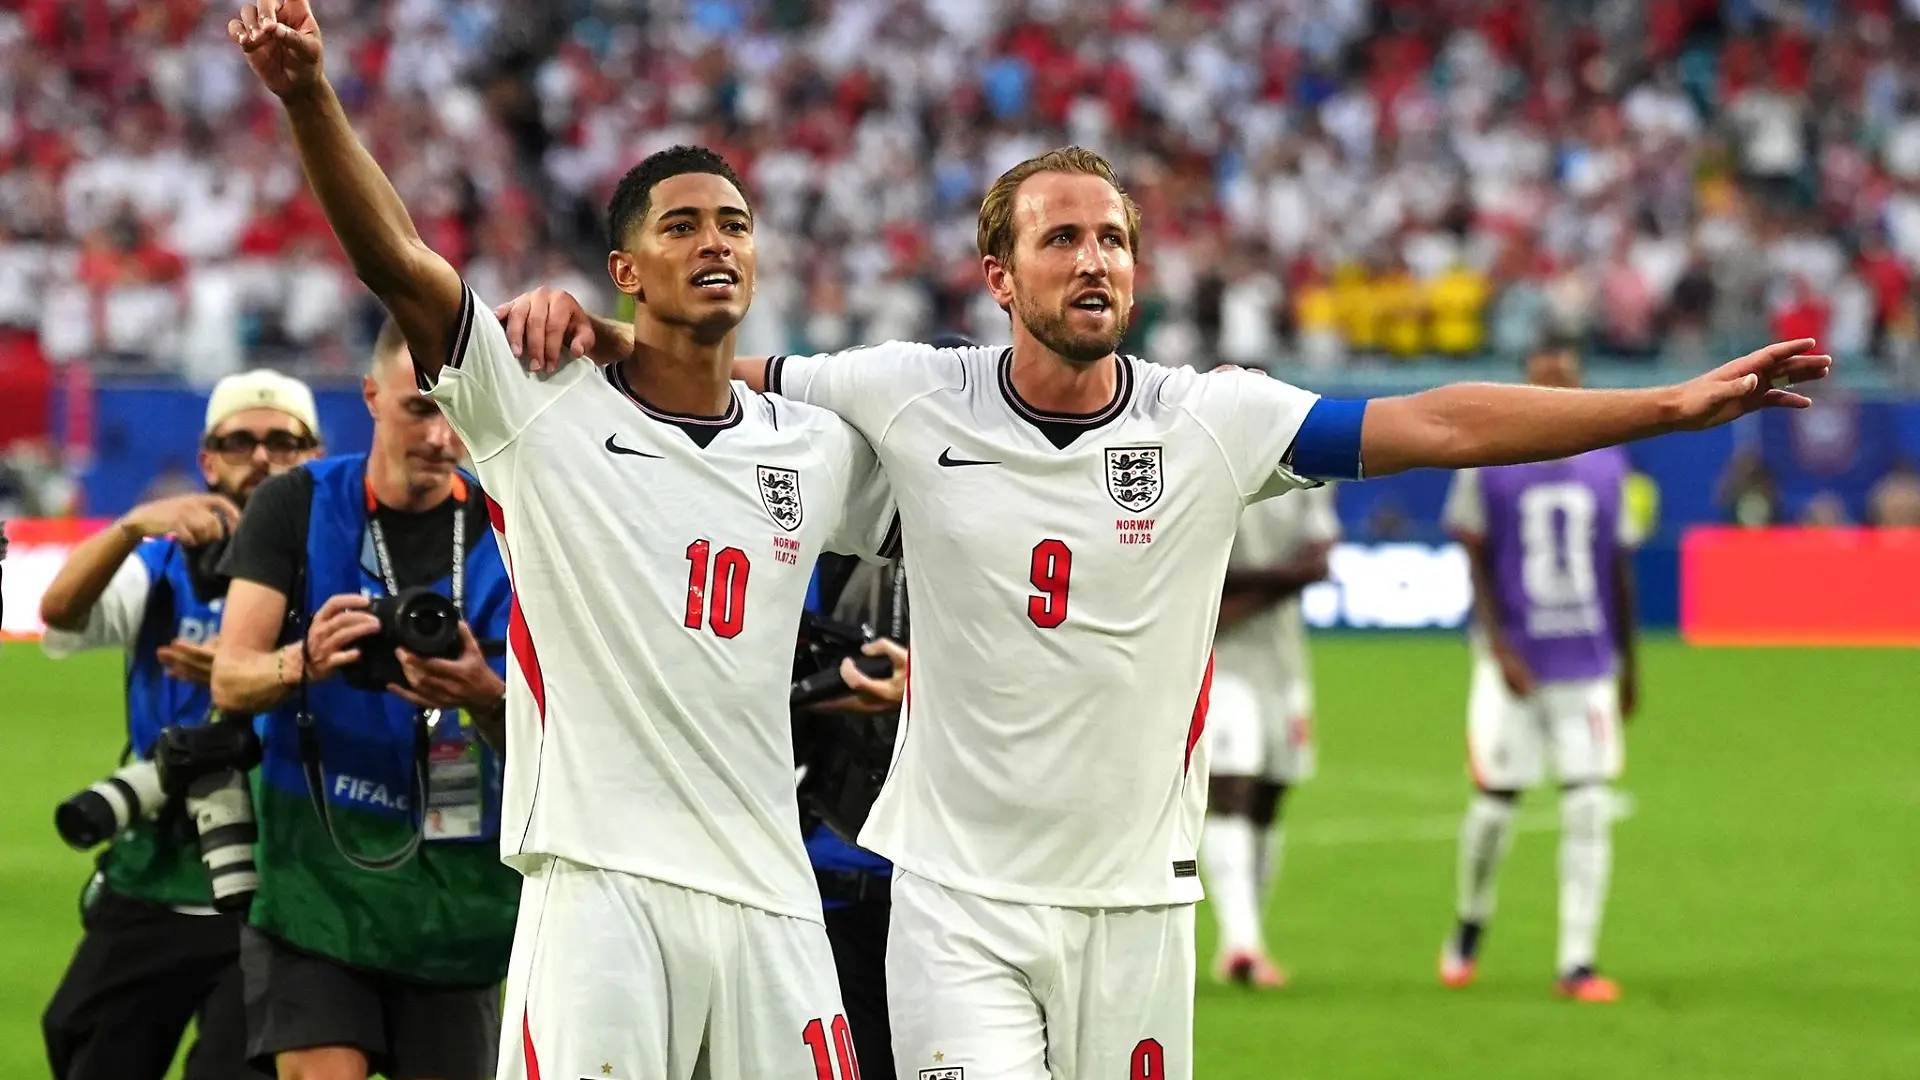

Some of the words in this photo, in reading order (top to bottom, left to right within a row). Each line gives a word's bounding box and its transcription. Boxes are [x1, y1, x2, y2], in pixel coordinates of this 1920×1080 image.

[1115, 520, 1155, 530] NORWAY
[1119, 533, 1151, 544] 11.07.26
[684, 538, 751, 640] 10
[1027, 538, 1072, 629] 9
[802, 1013, 862, 1080] 10
